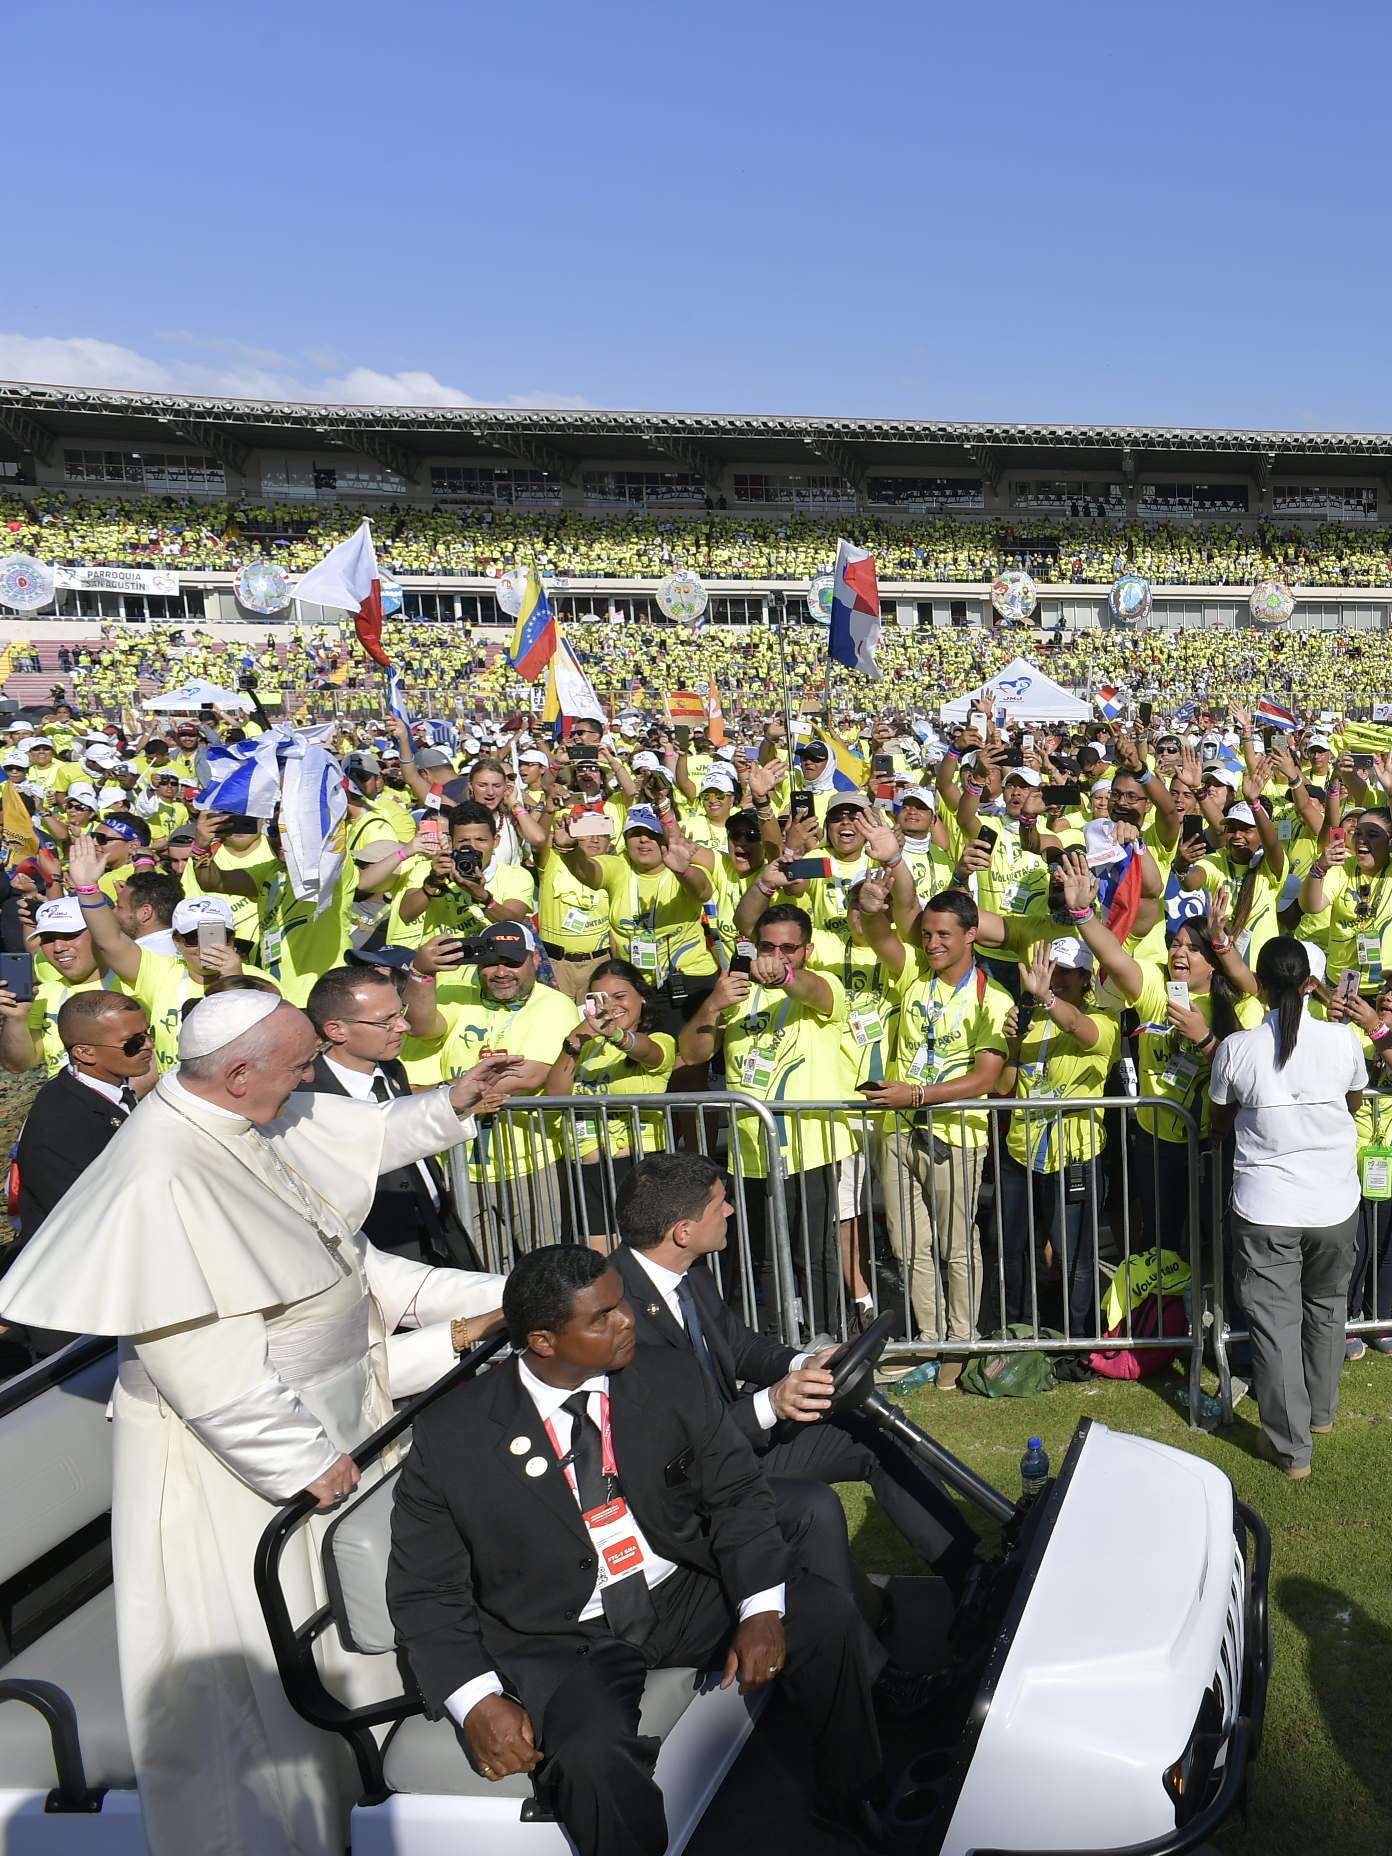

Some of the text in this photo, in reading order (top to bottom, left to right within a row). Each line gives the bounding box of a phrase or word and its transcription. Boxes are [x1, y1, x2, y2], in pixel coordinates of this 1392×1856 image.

[87, 570, 141, 581] PARROQUIA
[991, 861, 1040, 883] VOLUNTAO
[1132, 1261, 1180, 1297] VOLUTARIO
